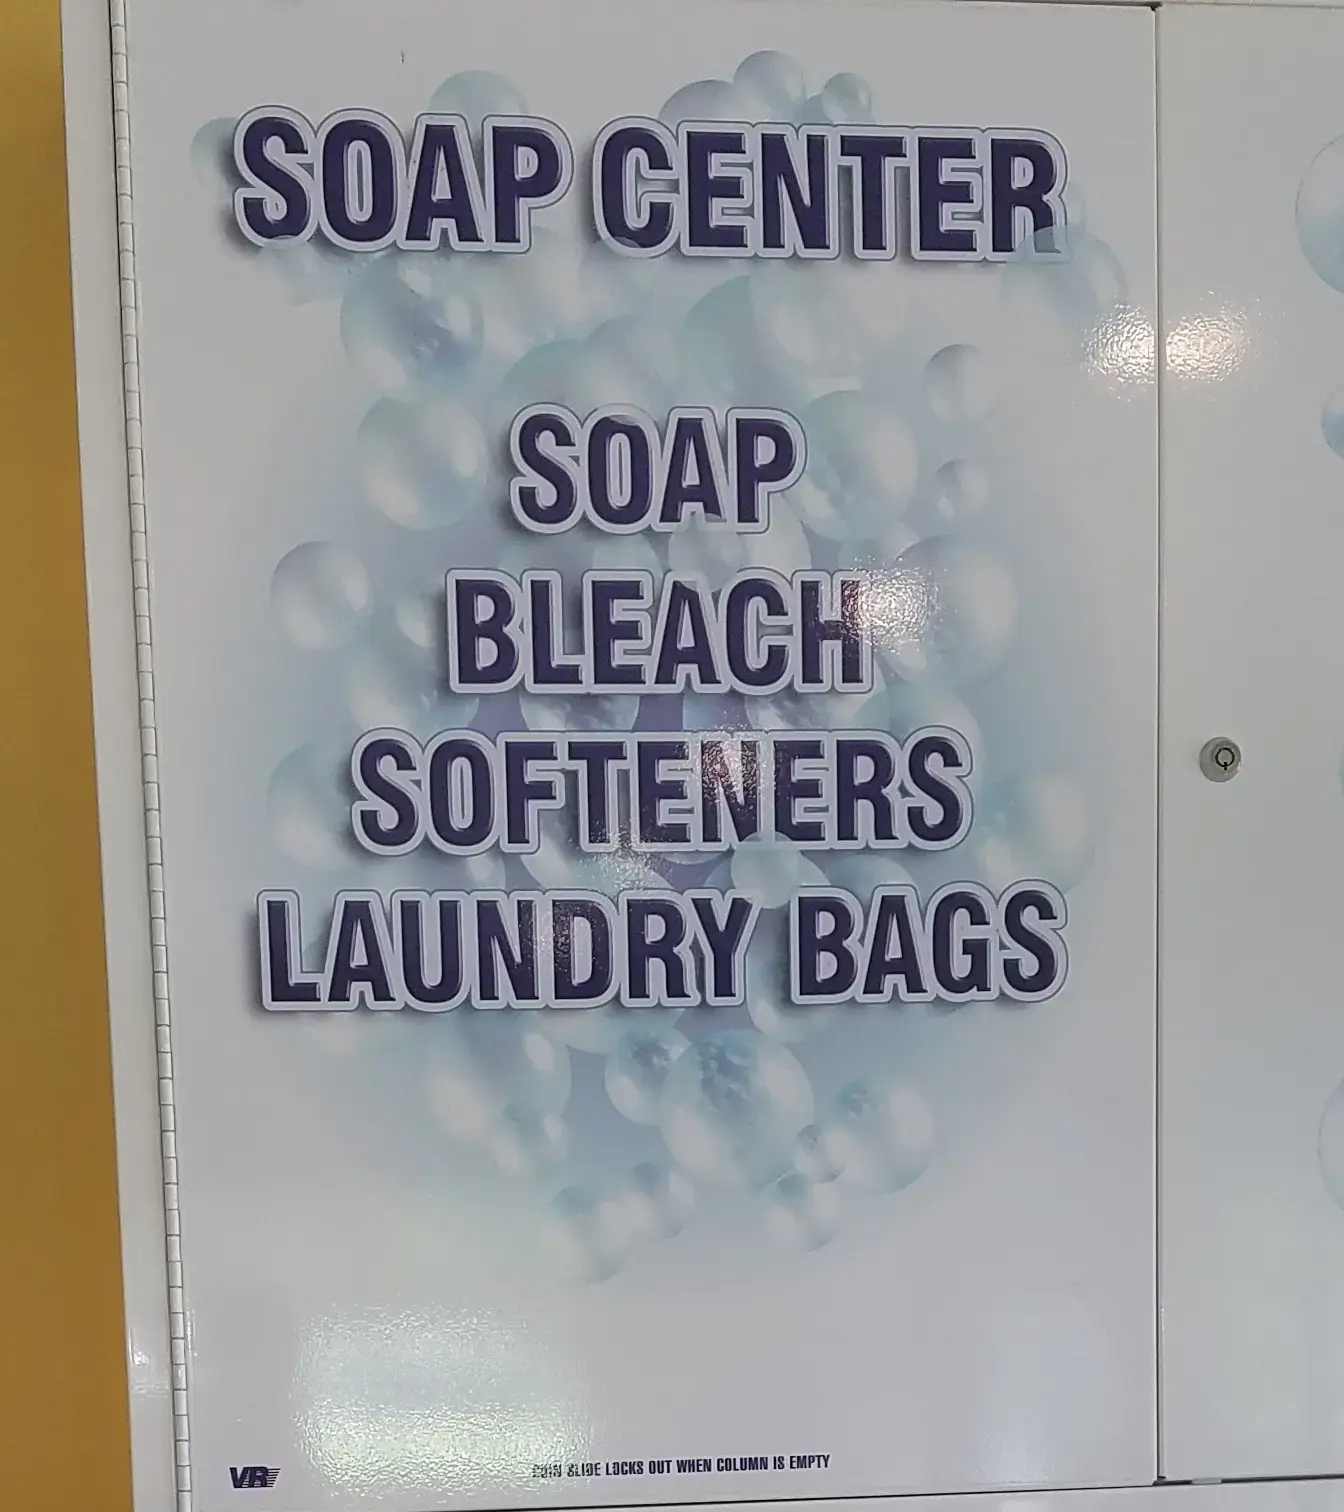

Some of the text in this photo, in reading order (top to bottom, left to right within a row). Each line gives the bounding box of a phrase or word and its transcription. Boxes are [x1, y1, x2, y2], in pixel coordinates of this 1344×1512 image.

[236, 112, 1064, 259] SOAP CENTER
[513, 407, 800, 530] SOAP
[450, 572, 868, 690] BLEACH
[354, 732, 969, 853] SOFTENERS
[261, 884, 1064, 1007] LAUNDRY BAGS
[605, 1460, 644, 1476] LOCKS
[648, 1459, 672, 1474] OUT
[676, 1458, 712, 1473] WHEN
[717, 1456, 768, 1472] COLUMN
[773, 1456, 785, 1470] IS
[789, 1454, 830, 1469] EMPTY
